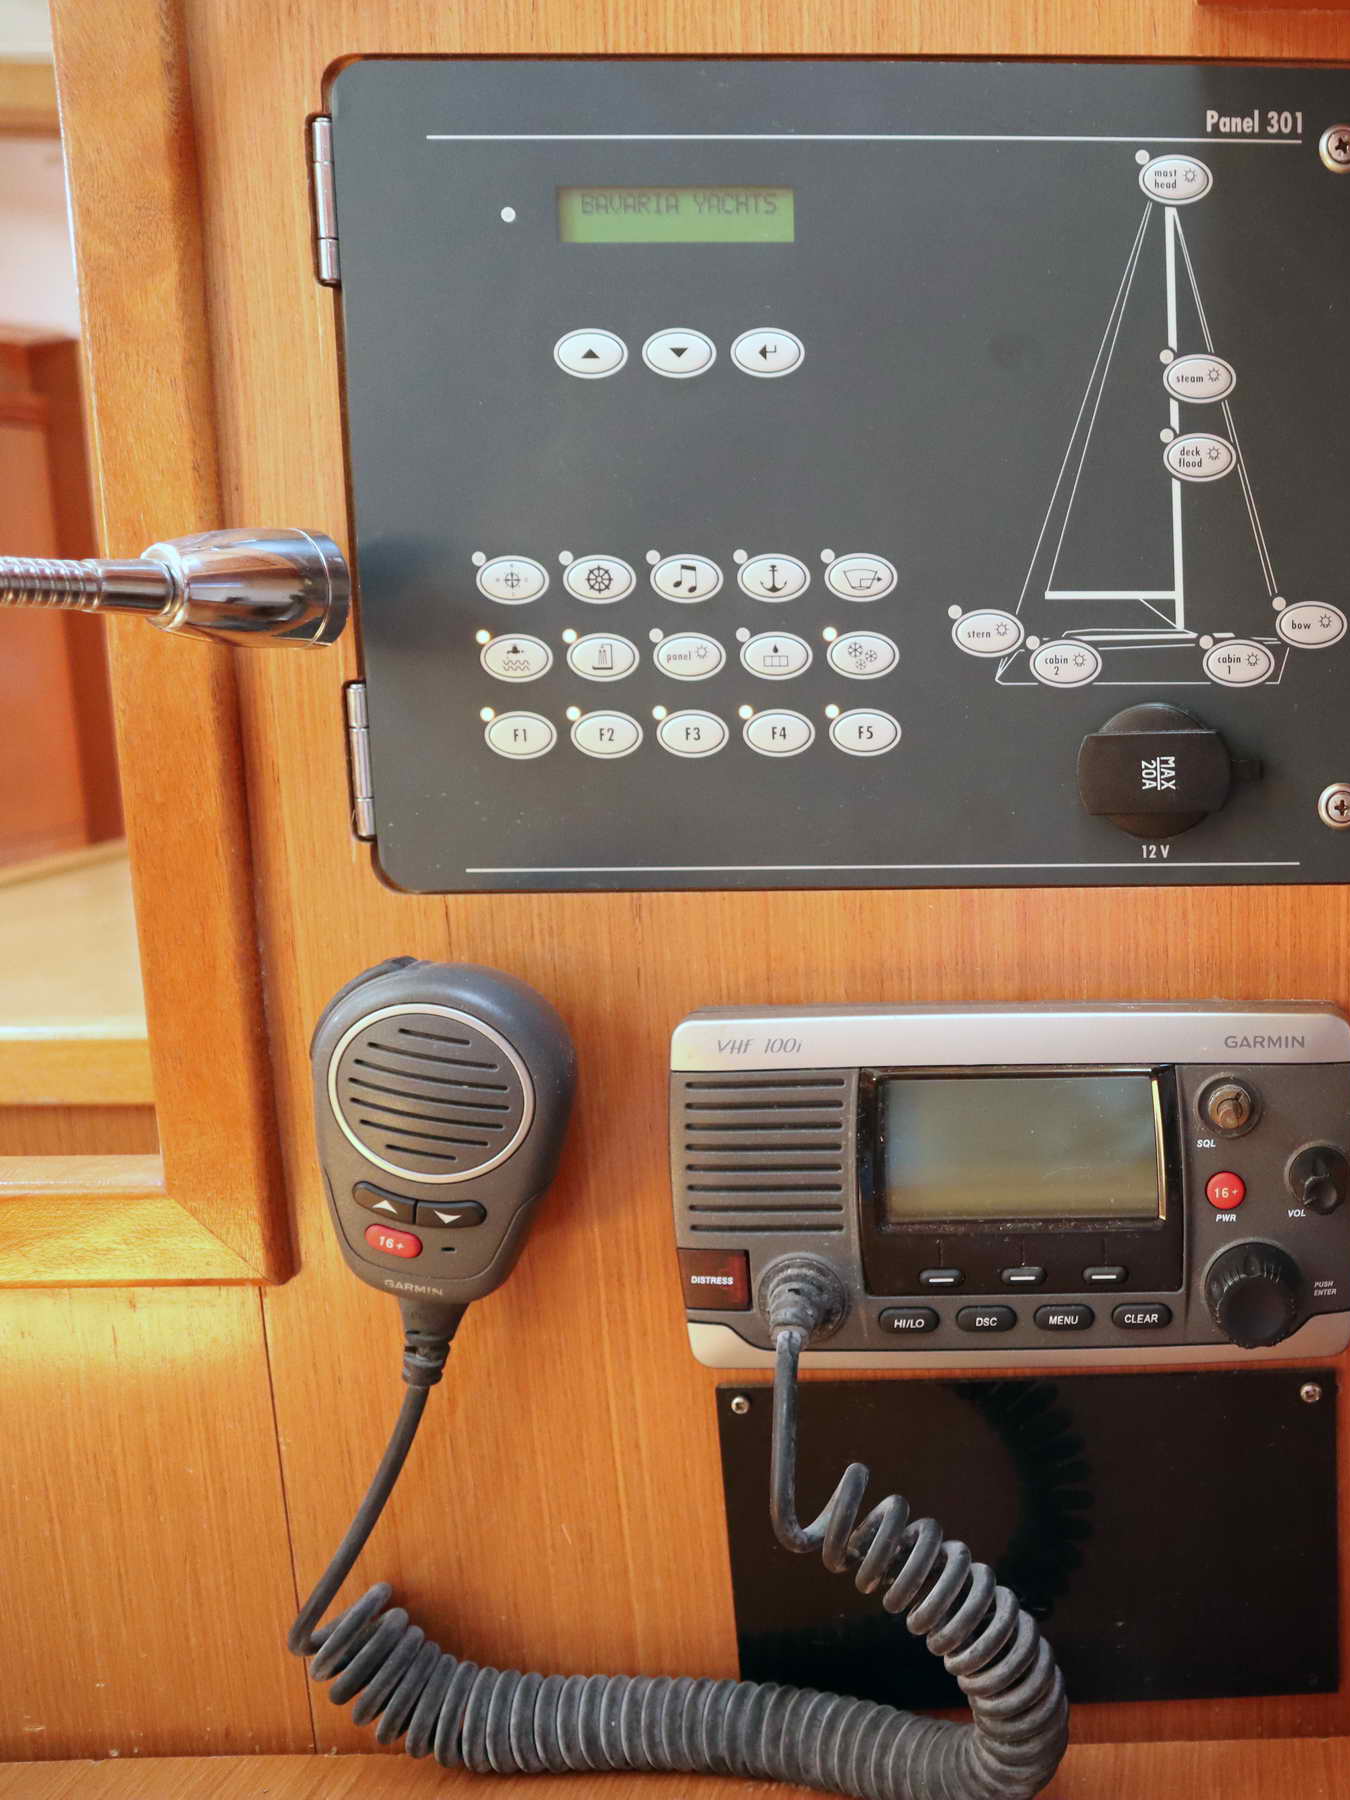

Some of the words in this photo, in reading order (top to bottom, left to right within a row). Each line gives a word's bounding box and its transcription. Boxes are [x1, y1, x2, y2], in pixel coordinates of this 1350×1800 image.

[1206, 110, 1259, 133] Panel
[1267, 111, 1303, 134] 301
[1154, 169, 1177, 177] mast
[1154, 178, 1177, 189] head
[580, 192, 680, 215] BAVARIA
[694, 192, 778, 215] YACHTS
[1176, 372, 1204, 383] steam
[1179, 446, 1201, 457] deck
[1178, 458, 1203, 468] flood
[1291, 619, 1311, 630] bow
[967, 628, 991, 639] stern
[666, 649, 692, 664] panel
[1045, 654, 1069, 665] cabin
[1217, 653, 1241, 665] cabin
[1053, 666, 1060, 675] 2
[1227, 666, 1232, 675] 1
[513, 728, 528, 743] F1
[599, 728, 615, 742] F2
[685, 727, 701, 741] F3
[771, 727, 787, 740] F4
[858, 726, 874, 740] F5
[1141, 759, 1157, 790] 20A
[1160, 756, 1177, 790] MAX
[717, 1039, 755, 1054] VHF
[1223, 1035, 1305, 1049] GARMIN
[1197, 1139, 1217, 1148] SQL
[1215, 1213, 1237, 1222] PWR
[1287, 1208, 1306, 1218] VOL
[690, 1275, 734, 1285] DISTRESS
[383, 1279, 444, 1297] GARMIN
[894, 1318, 925, 1329] HI/LO
[975, 1317, 998, 1327] DSC
[1048, 1315, 1079, 1325] MENU
[1124, 1313, 1159, 1324] CLEAR
